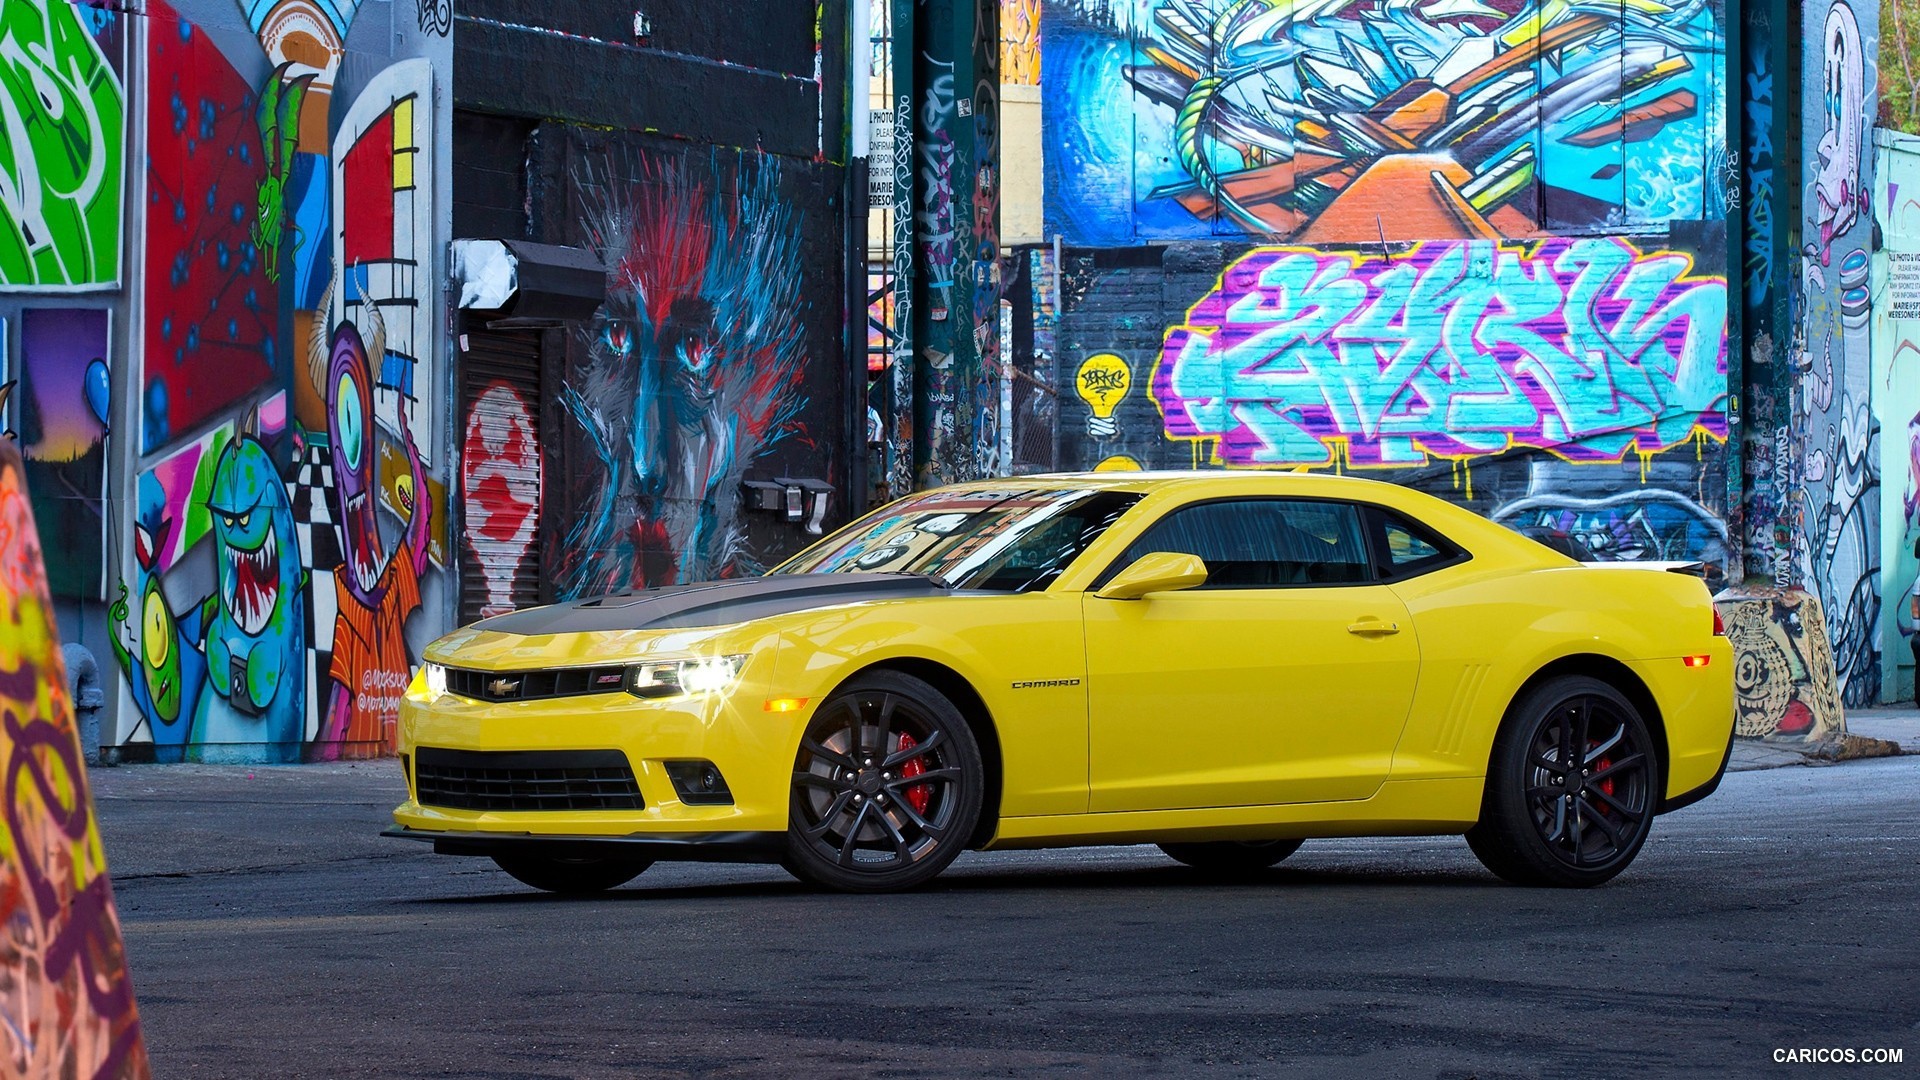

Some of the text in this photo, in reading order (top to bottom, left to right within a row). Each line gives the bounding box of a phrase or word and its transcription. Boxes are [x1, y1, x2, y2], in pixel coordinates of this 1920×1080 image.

[874, 112, 894, 123] PHOTO
[876, 128, 894, 137] PLEAS
[869, 141, 894, 150] ONFIRMA
[880, 167, 894, 177] INFO
[870, 182, 893, 193] MARIE
[869, 194, 894, 206] ERESON
[1011, 679, 1080, 689] CAMARO
